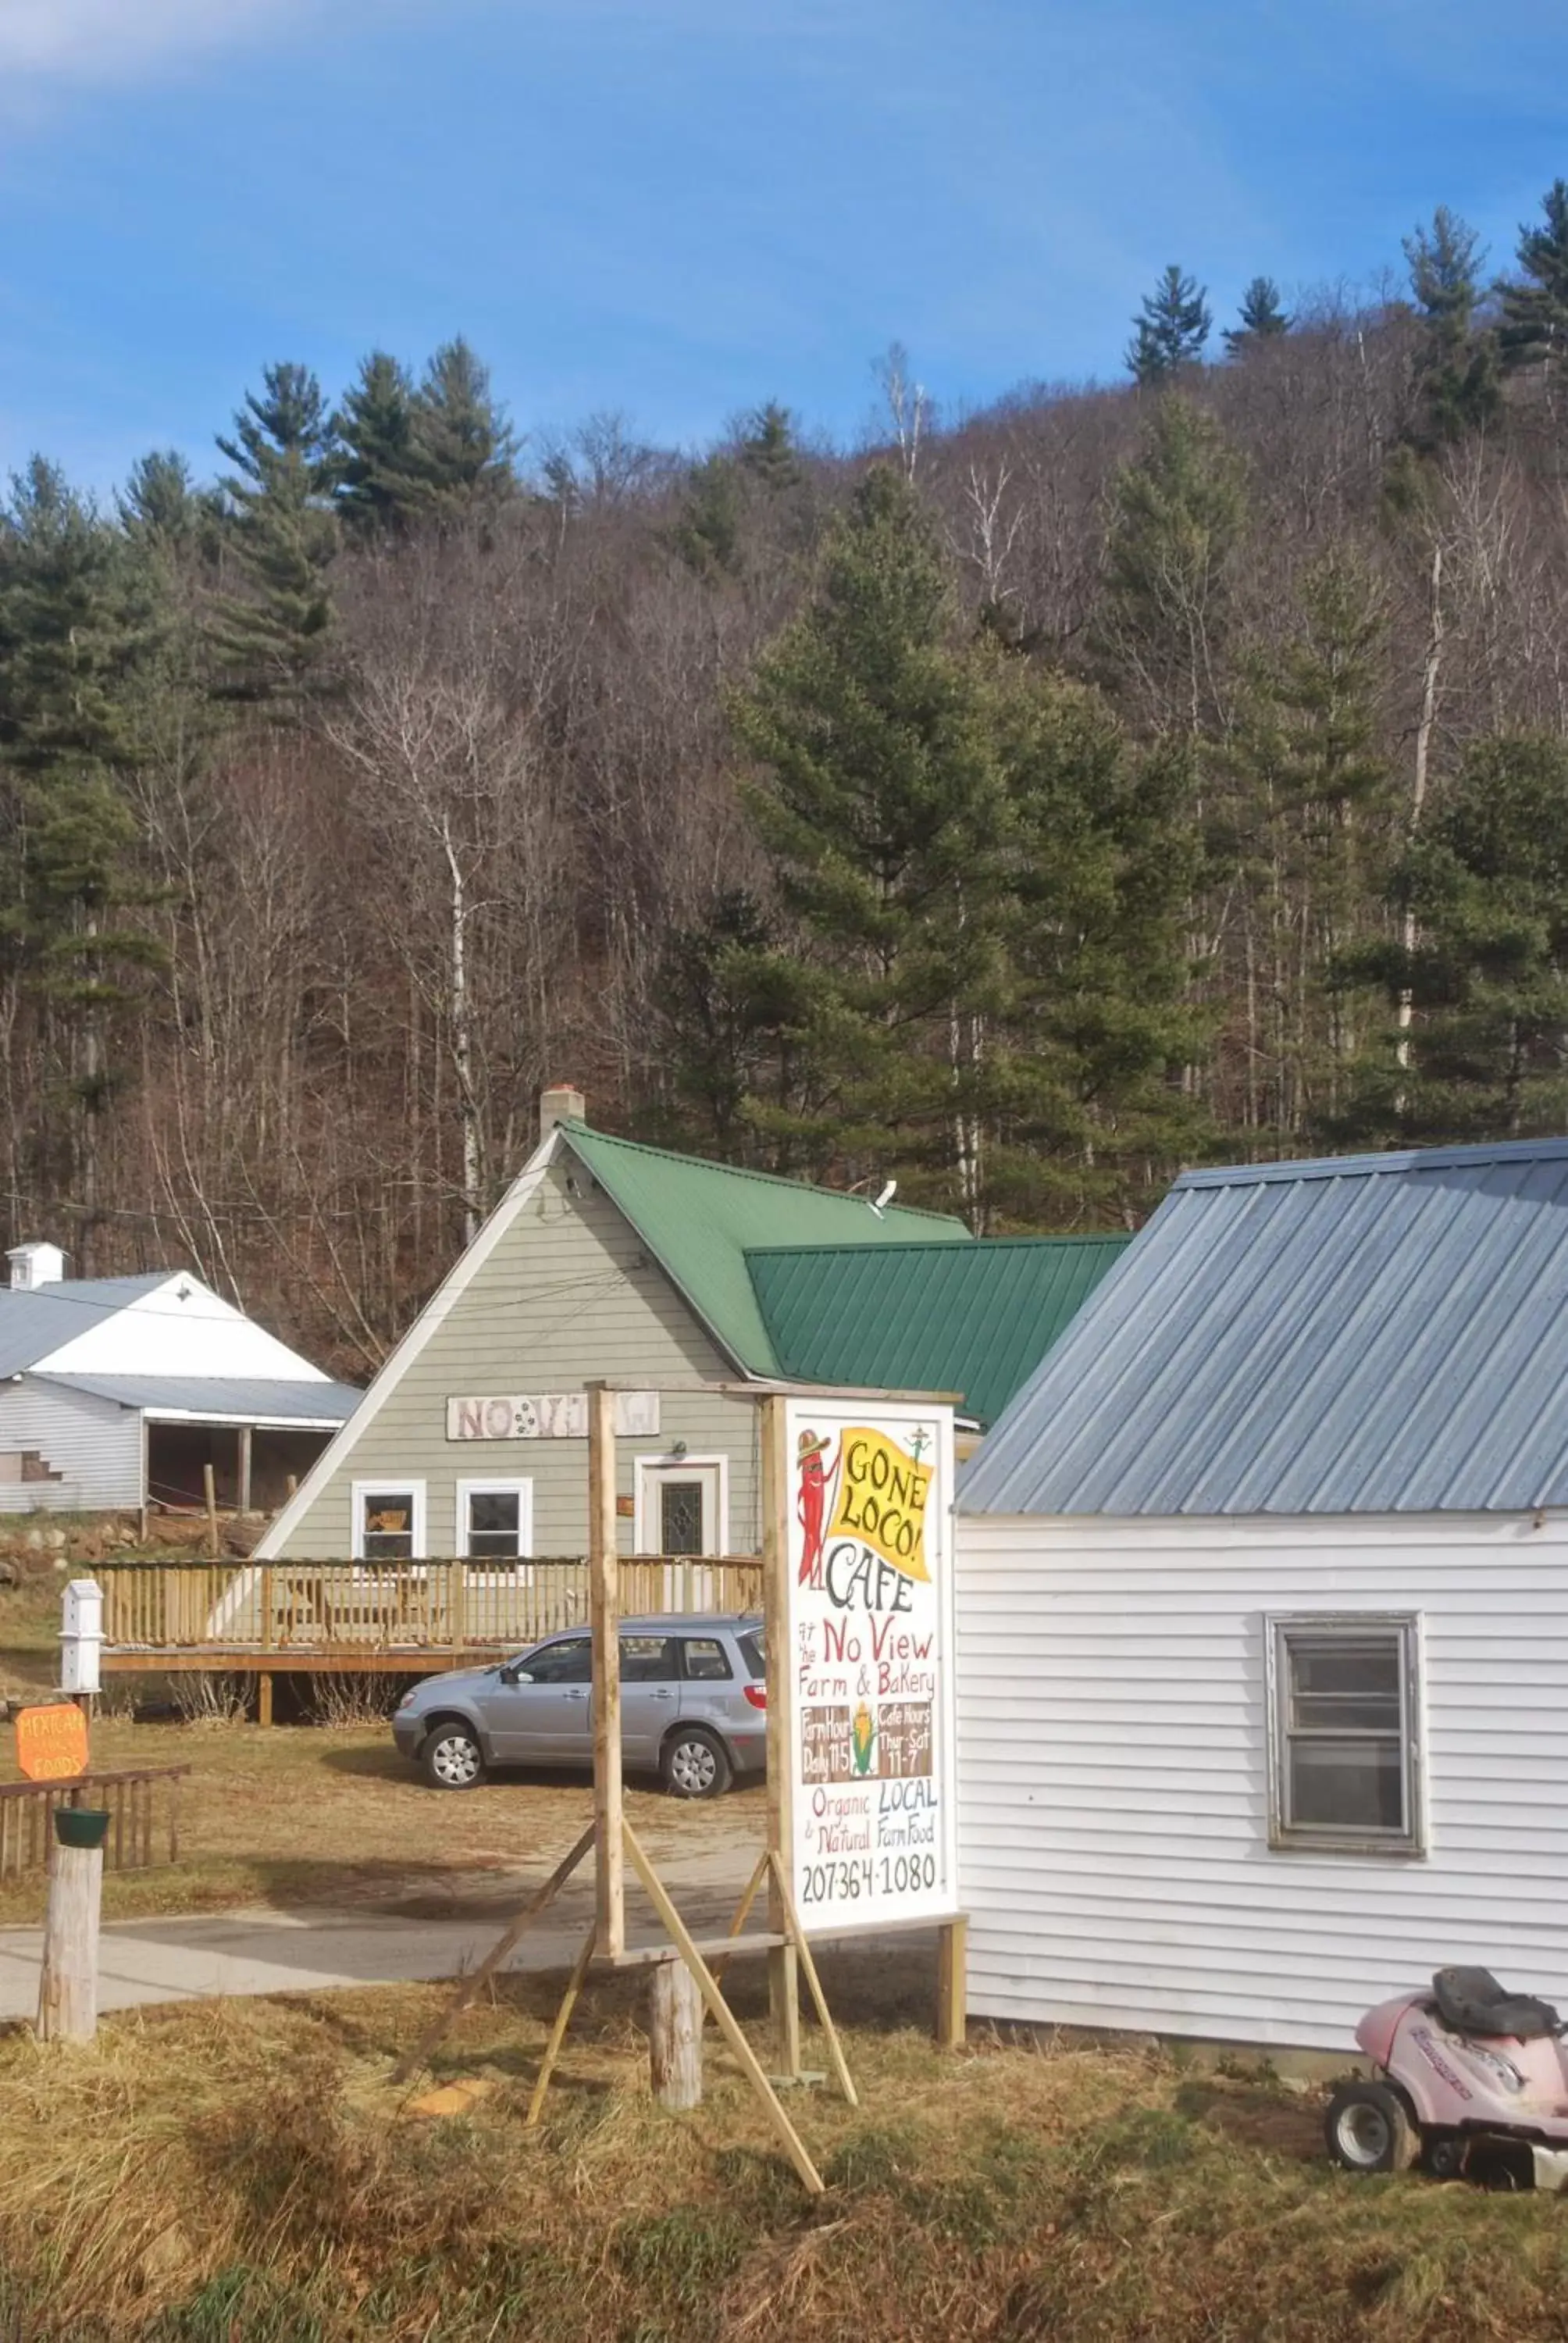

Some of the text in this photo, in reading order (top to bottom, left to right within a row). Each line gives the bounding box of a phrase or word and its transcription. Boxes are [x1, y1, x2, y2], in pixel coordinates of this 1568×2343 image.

[457, 1395, 657, 1438] NO VIW
[846, 1439, 927, 1510] GONE
[839, 1485, 923, 1561] LOCO!
[825, 1542, 914, 1612] CAFE
[823, 1612, 934, 1663] No View
[799, 1664, 847, 1696] Farm
[857, 1664, 871, 1696] &
[812, 1779, 937, 1828] Organic LOCAL
